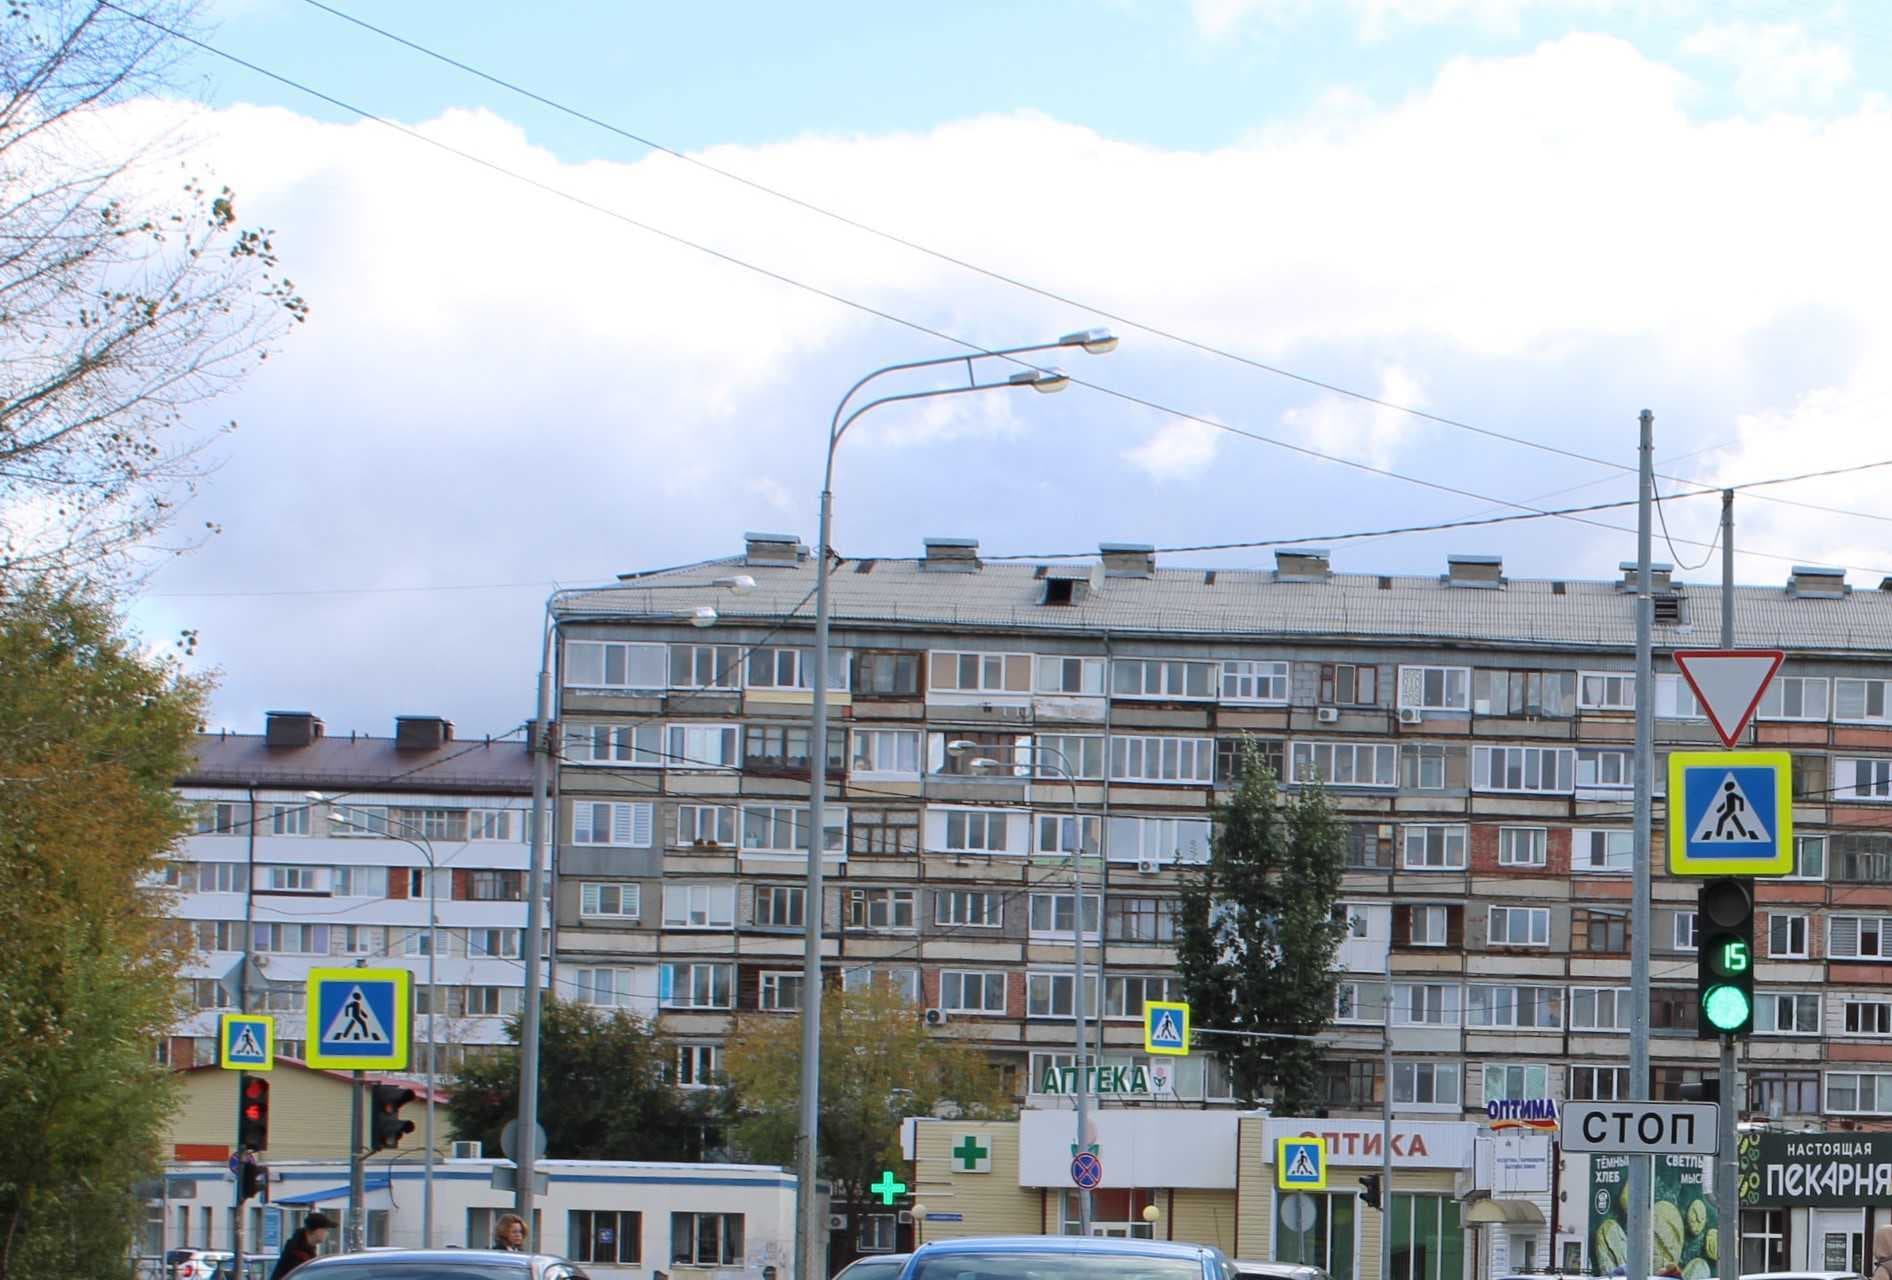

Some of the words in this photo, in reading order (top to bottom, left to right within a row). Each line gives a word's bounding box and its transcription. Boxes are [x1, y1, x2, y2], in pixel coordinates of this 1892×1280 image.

[1725, 943, 1747, 971] 15
[1042, 1066, 1150, 1094] АПТЕКА
[1487, 1099, 1558, 1120] ОПТИМА
[1583, 1111, 1695, 1145] СТОП
[1298, 1131, 1429, 1157] ПТИКА
[1787, 1142, 1872, 1157] НАСТОЯЩАЯ
[1595, 1154, 1630, 1169] ТЁМНЫ
[1595, 1171, 1620, 1183] ХЛЕБ
